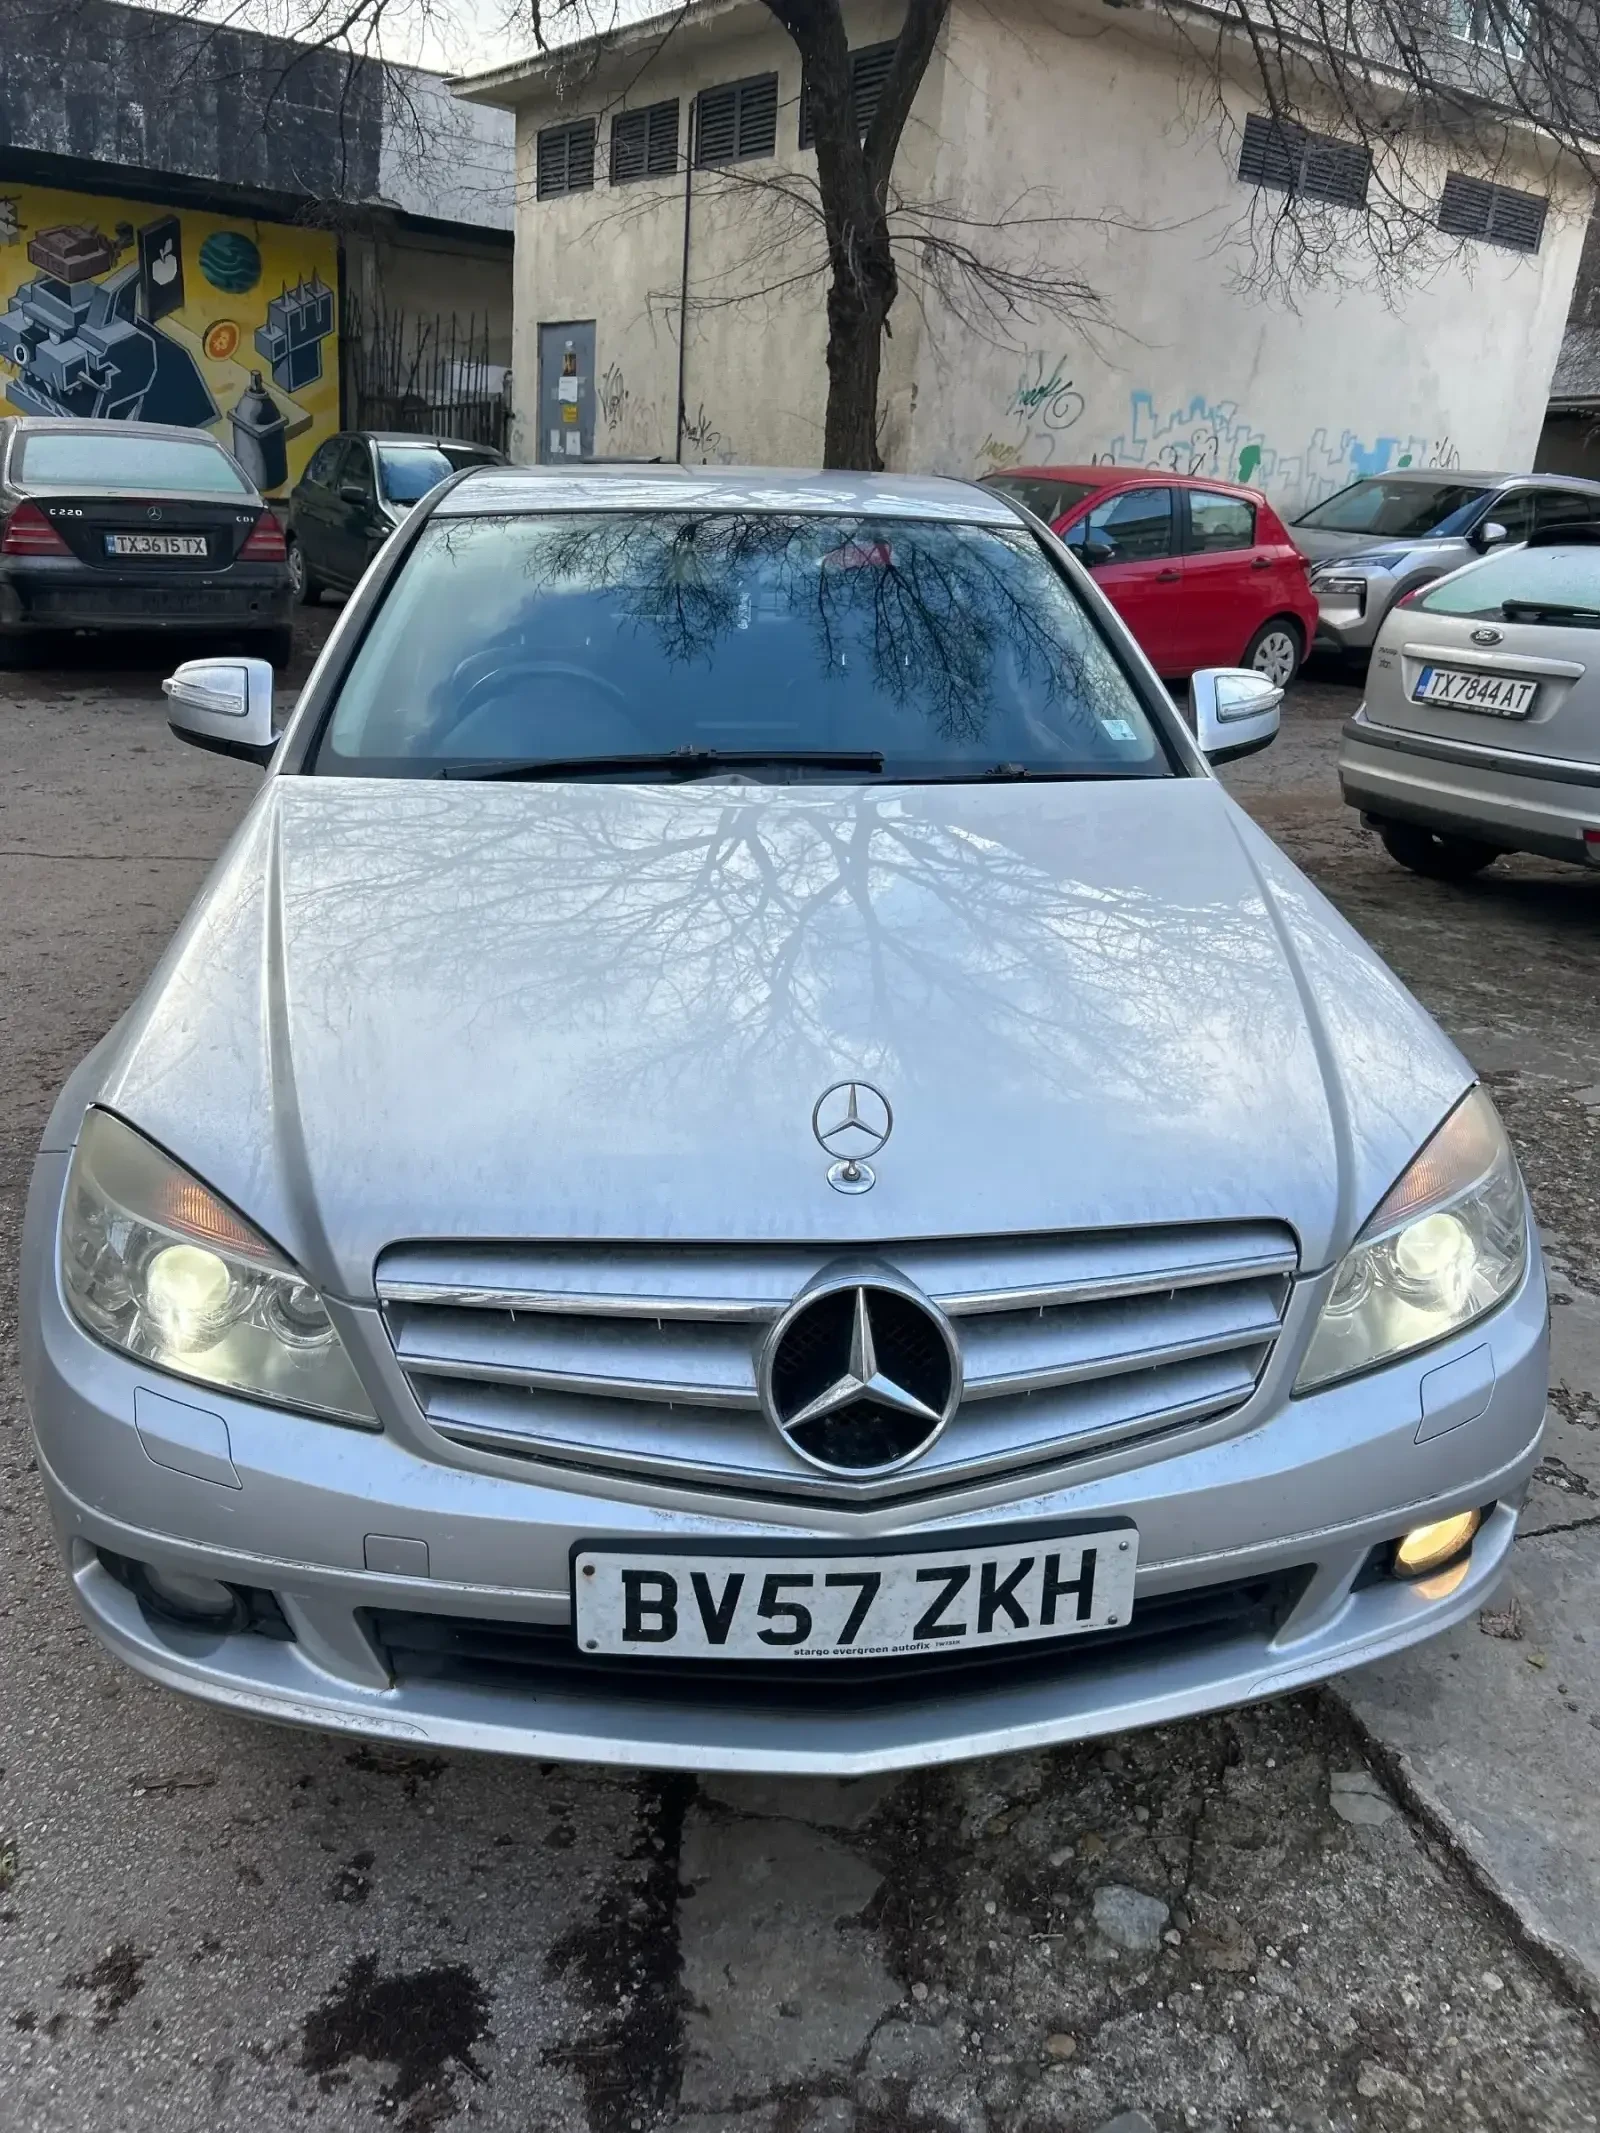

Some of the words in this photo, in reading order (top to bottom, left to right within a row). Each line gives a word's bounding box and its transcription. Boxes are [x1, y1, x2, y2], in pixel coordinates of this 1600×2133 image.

[621, 1569, 882, 1646] BV57
[912, 1548, 1098, 1641] ZKH
[793, 1648, 829, 1656] stargo
[832, 1646, 889, 1656] evergreen
[891, 1642, 930, 1652] autofix
